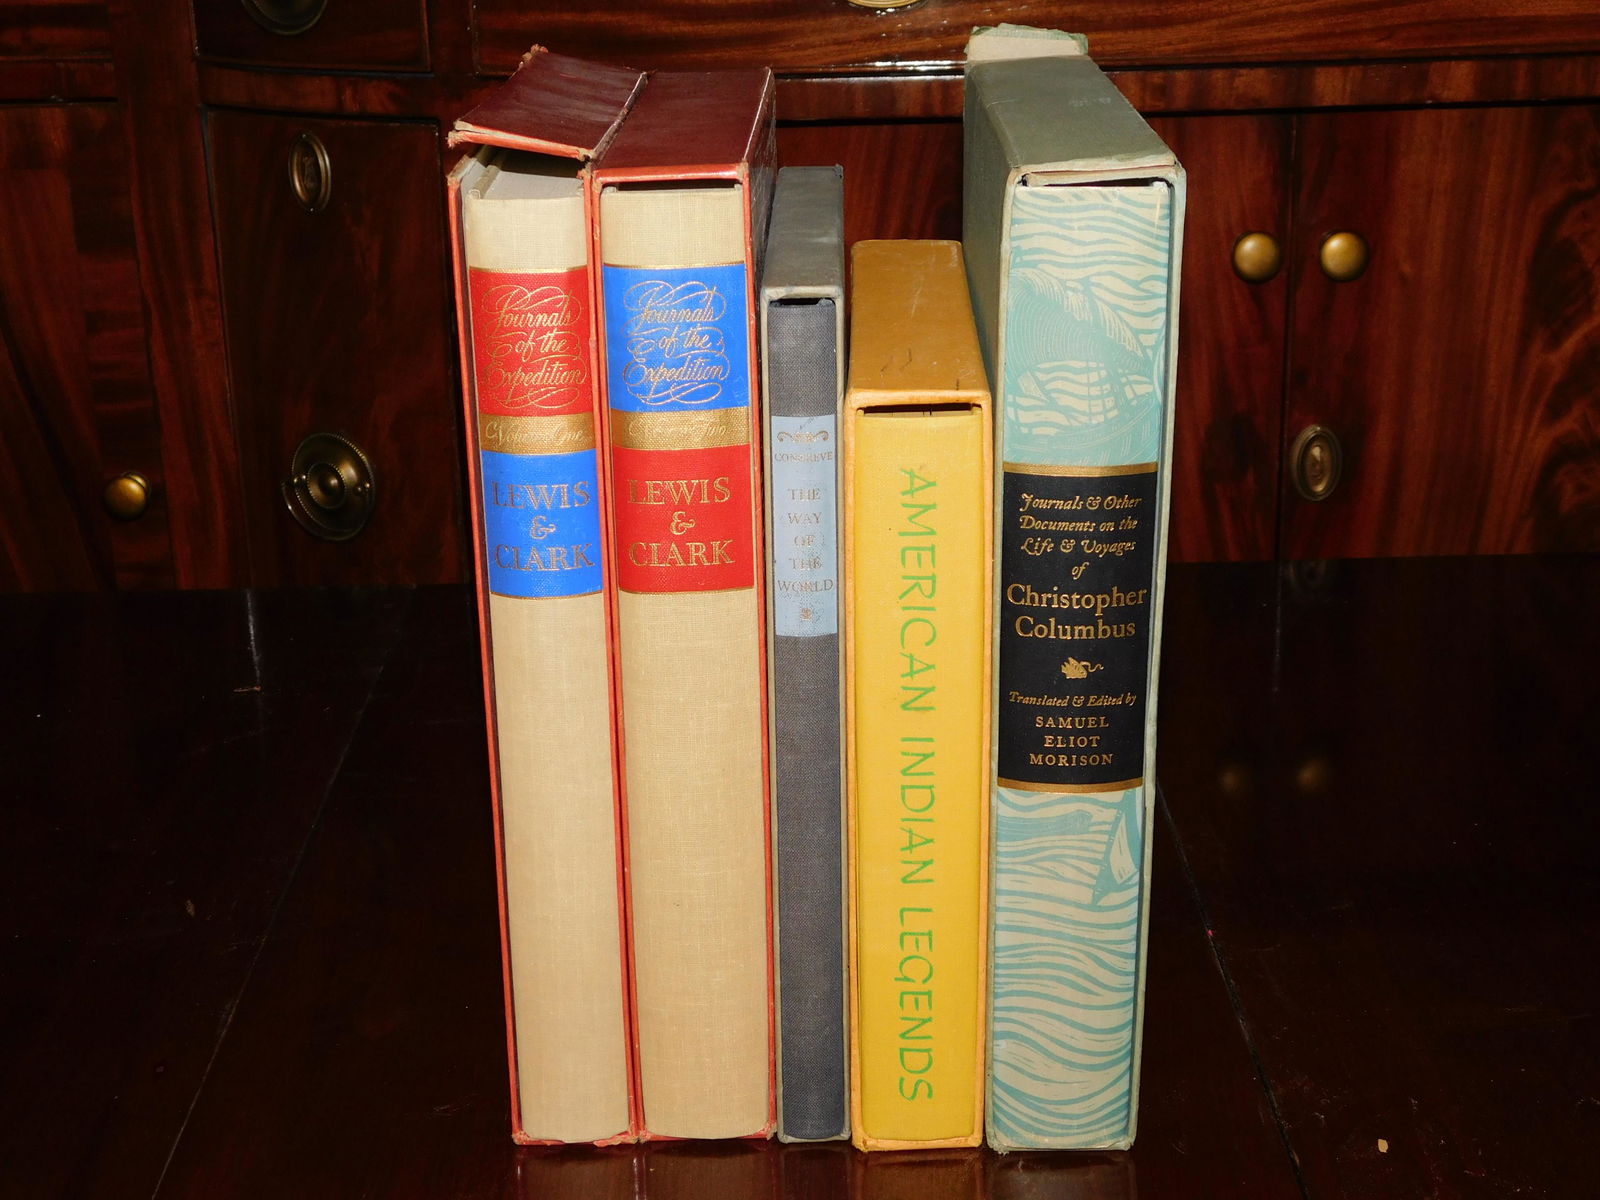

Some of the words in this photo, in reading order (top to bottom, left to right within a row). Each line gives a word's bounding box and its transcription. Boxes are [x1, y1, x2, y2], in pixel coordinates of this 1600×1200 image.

[483, 284, 581, 336] Journals
[623, 280, 727, 334] Journals
[514, 328, 536, 361] of
[539, 329, 569, 354] the
[658, 323, 680, 358] of
[683, 324, 713, 351] the
[482, 355, 588, 410] Expedition
[622, 352, 731, 406] Expedition
[491, 481, 590, 509] LEWIS
[627, 476, 732, 505] LEWIS
[787, 487, 822, 501] THE
[1019, 493, 1084, 512] Journals
[1086, 496, 1101, 510] &
[1103, 494, 1142, 510] Other
[529, 515, 556, 540] &
[669, 511, 696, 536] &
[787, 512, 823, 526] WAY
[1019, 515, 1096, 532] Documents
[1099, 521, 1115, 531] on
[1118, 515, 1138, 530] the
[793, 534, 816, 547] OF
[1020, 537, 1055, 556] Life
[1059, 538, 1076, 553] &
[1080, 540, 1137, 558] Voyages
[494, 544, 595, 572] CLARK
[628, 539, 736, 568] CLARK
[788, 557, 823, 571] THE
[1071, 562, 1089, 580] of
[777, 578, 834, 594] WORLD
[899, 467, 938, 713] AMERICAN
[1006, 583, 1148, 617] Christopher
[1014, 615, 1136, 640] Columbus
[1008, 691, 1069, 707] Translated
[1071, 695, 1085, 708] &
[1086, 693, 1123, 707] Edited
[1124, 692, 1137, 706] by
[1035, 716, 1110, 729] SAMUEL
[1043, 735, 1101, 748] ELIOT
[1029, 753, 1114, 767] MORISON
[899, 736, 936, 886] INDIAN
[897, 906, 934, 1103] LEGENDS
